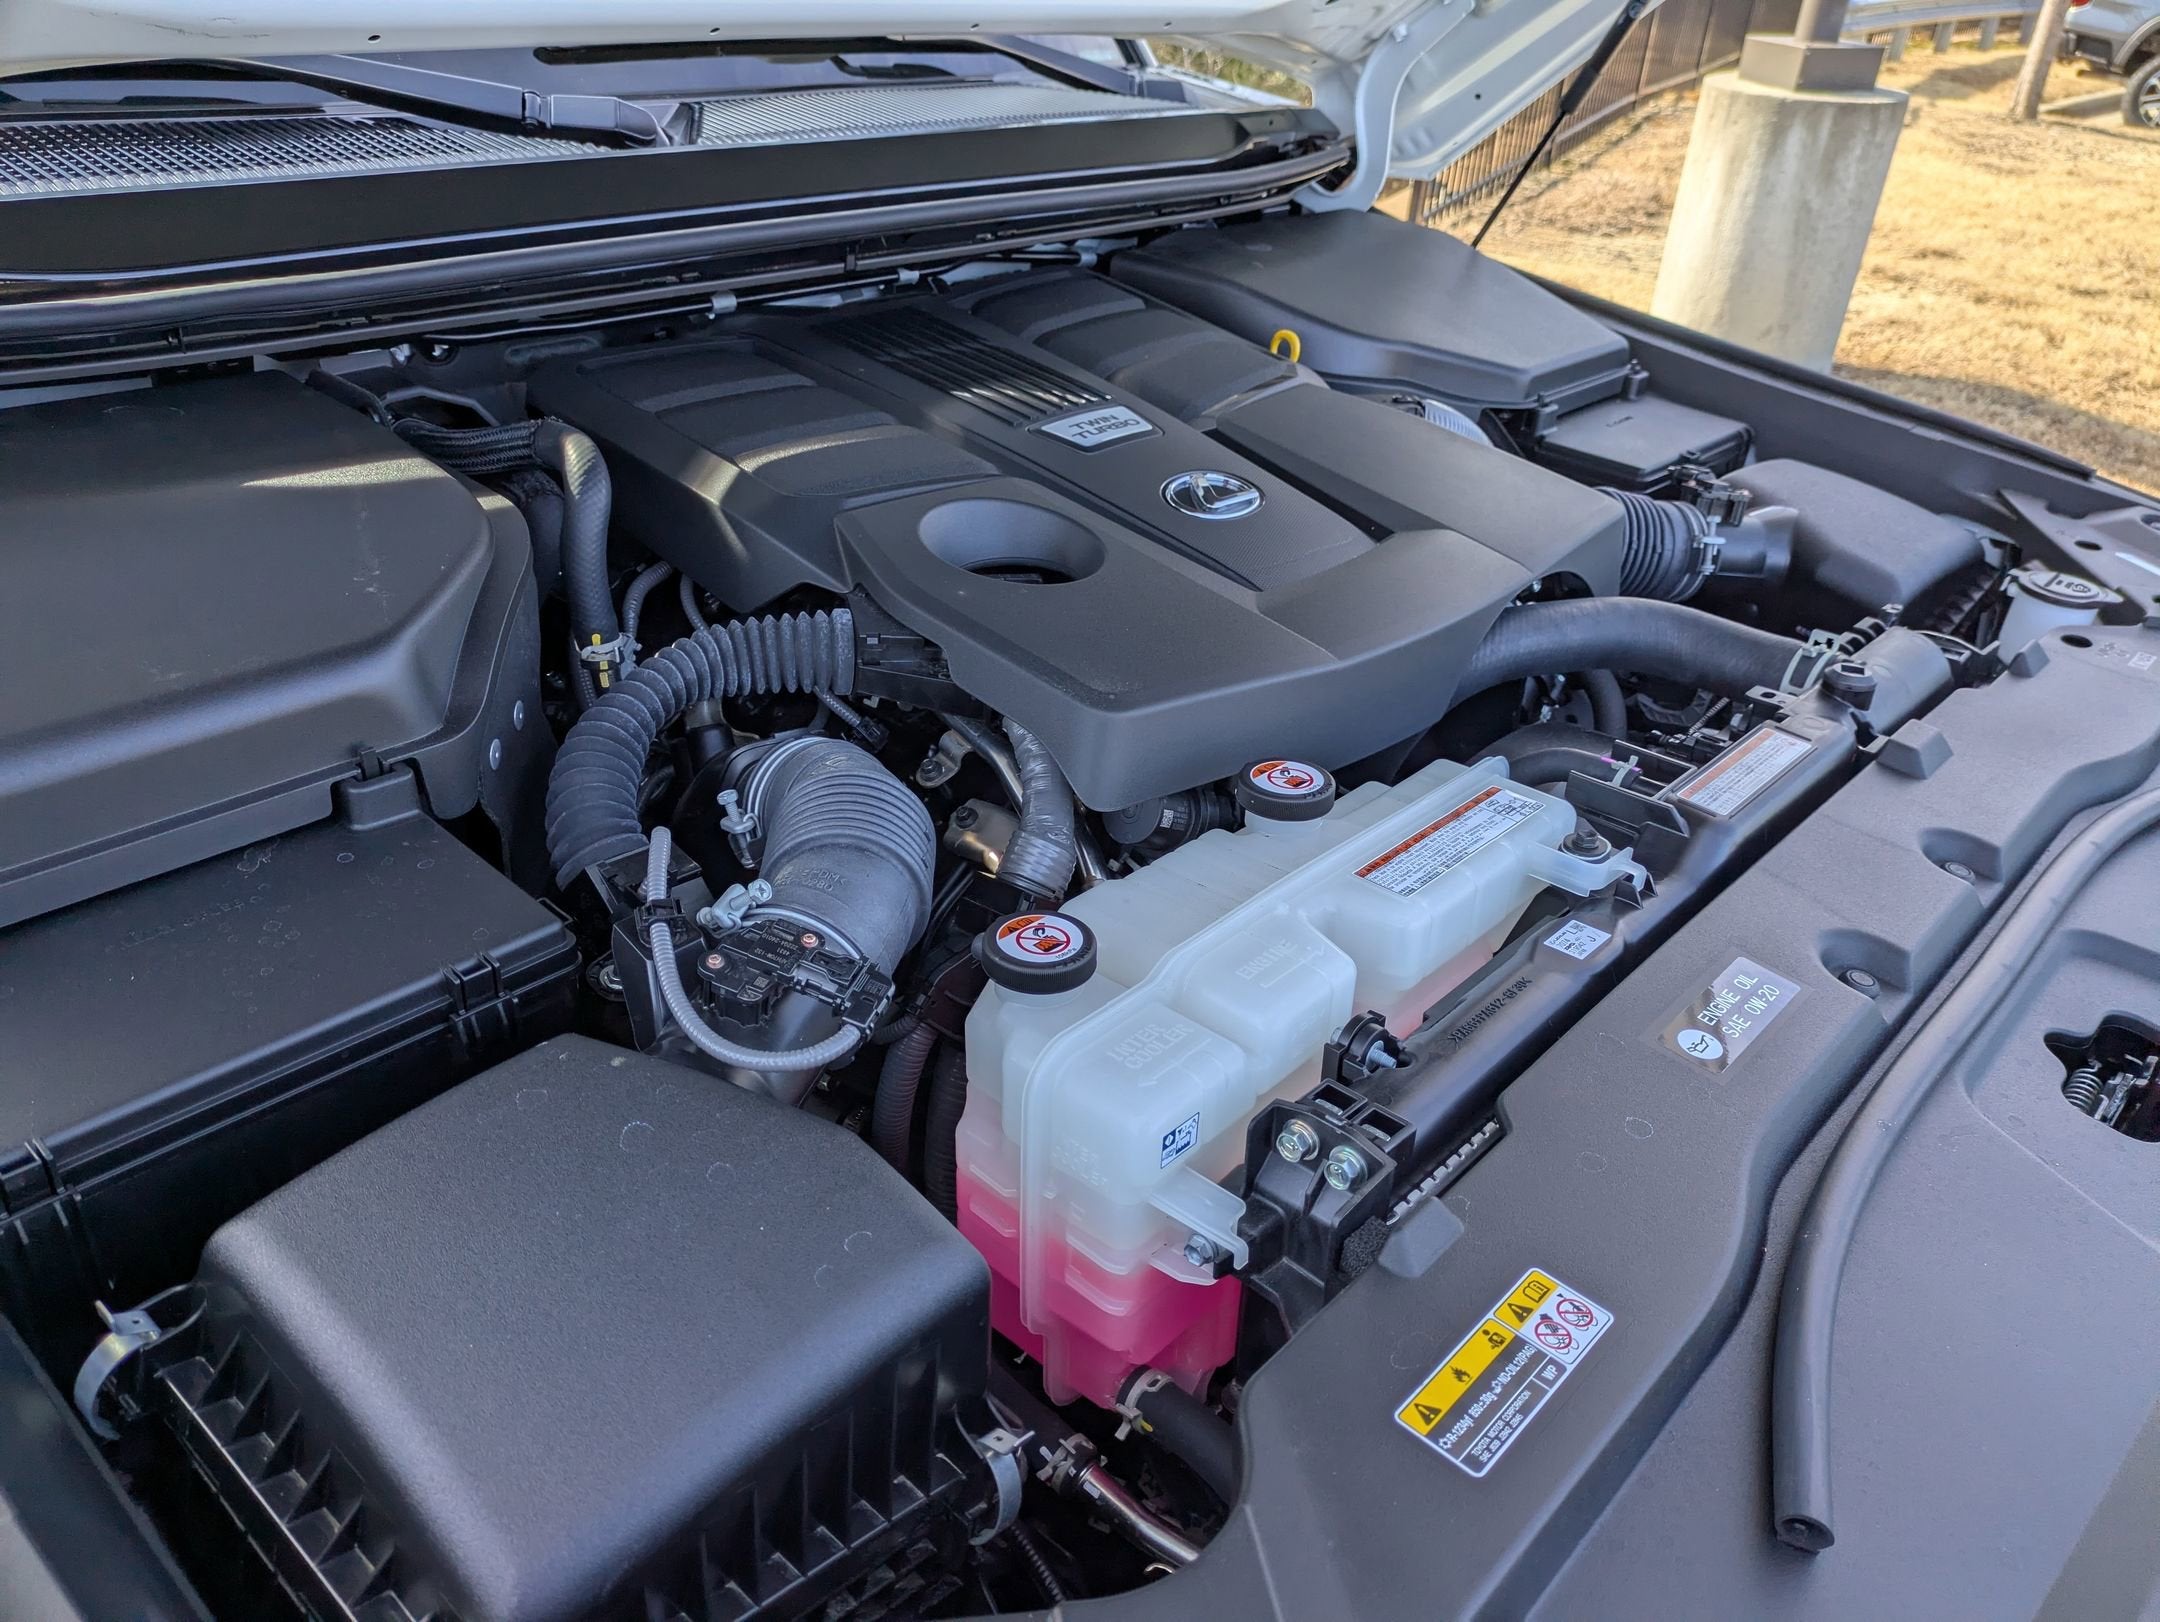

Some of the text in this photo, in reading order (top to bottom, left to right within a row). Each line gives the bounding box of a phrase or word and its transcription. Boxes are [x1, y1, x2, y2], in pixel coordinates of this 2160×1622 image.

[1068, 414, 1119, 430] TWIN
[1072, 419, 1140, 439] TURBO
[1235, 939, 1298, 980] ENGINE
[1697, 974, 1759, 1026] ENGINE OIL
[1721, 984, 1780, 1038] SAE 0W-20
[1106, 1024, 1166, 1061] INTER
[1124, 1023, 1195, 1069] COOLER
[1541, 1364, 1558, 1380] WP
[1471, 1390, 1531, 1456] TOYOTA MOTOR CORPORATION
